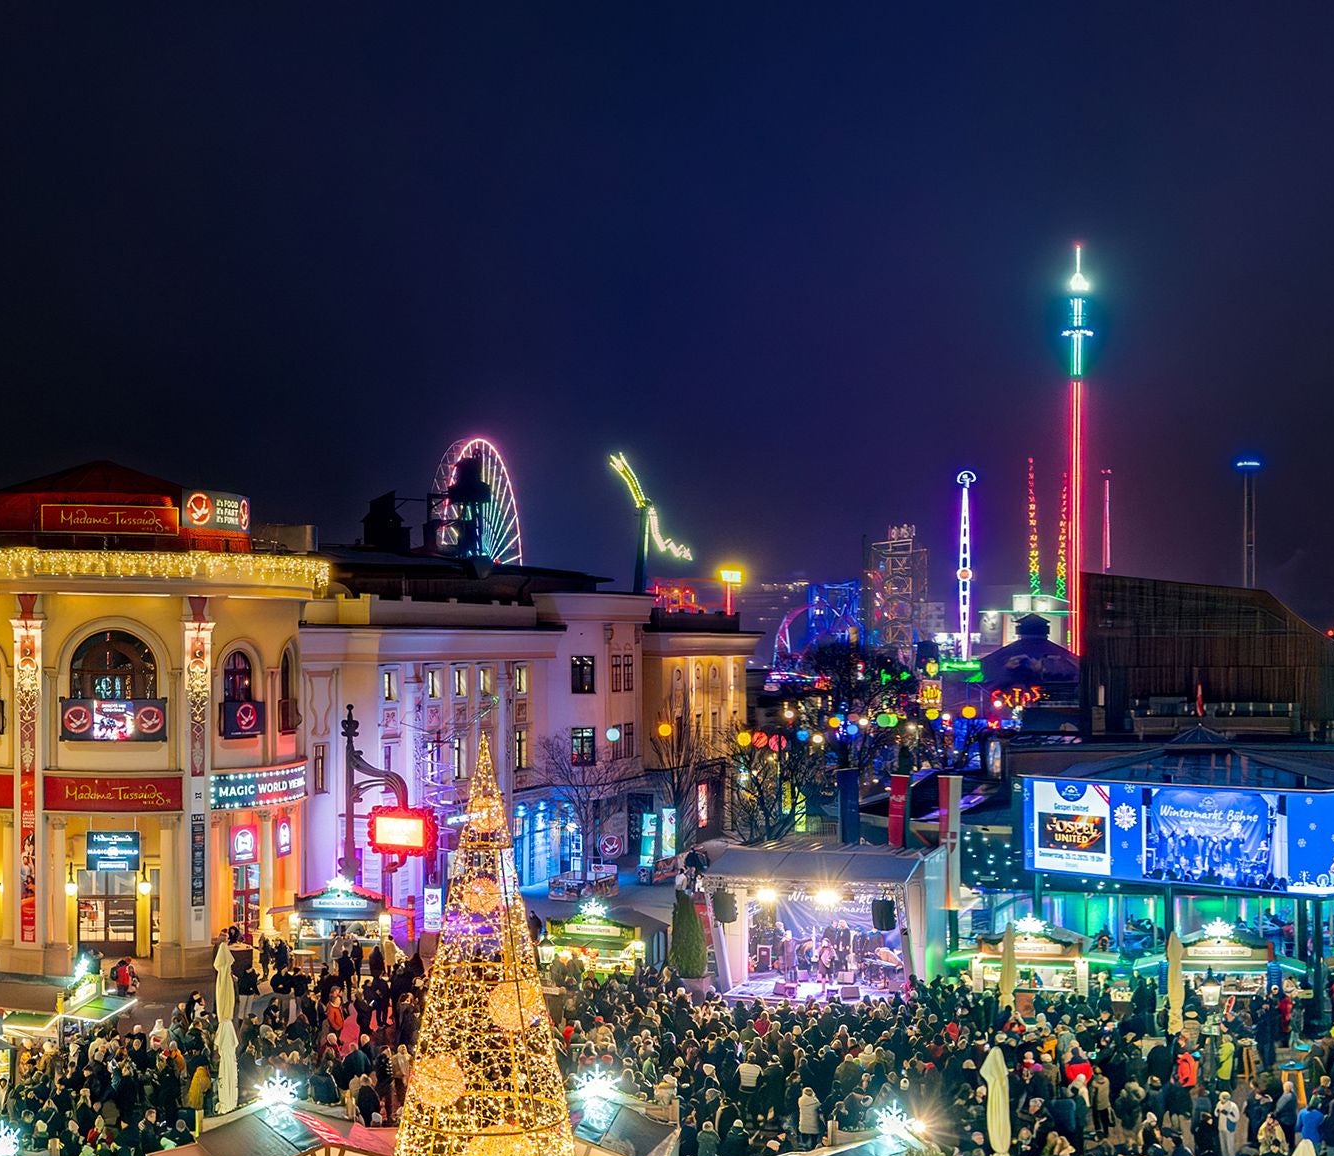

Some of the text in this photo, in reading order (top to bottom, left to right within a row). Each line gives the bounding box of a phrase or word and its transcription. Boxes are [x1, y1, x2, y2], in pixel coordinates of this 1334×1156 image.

[224, 499, 239, 508] FOOD
[60, 509, 164, 532] Madame Tussauds
[224, 509, 239, 517] FAST
[65, 784, 165, 805] Madame Tussauds
[218, 785, 255, 797] MAGIC
[257, 781, 287, 794] WORLD
[1159, 805, 1258, 823] Wintermarkt Bühne
[1054, 833, 1089, 844] UNITED
